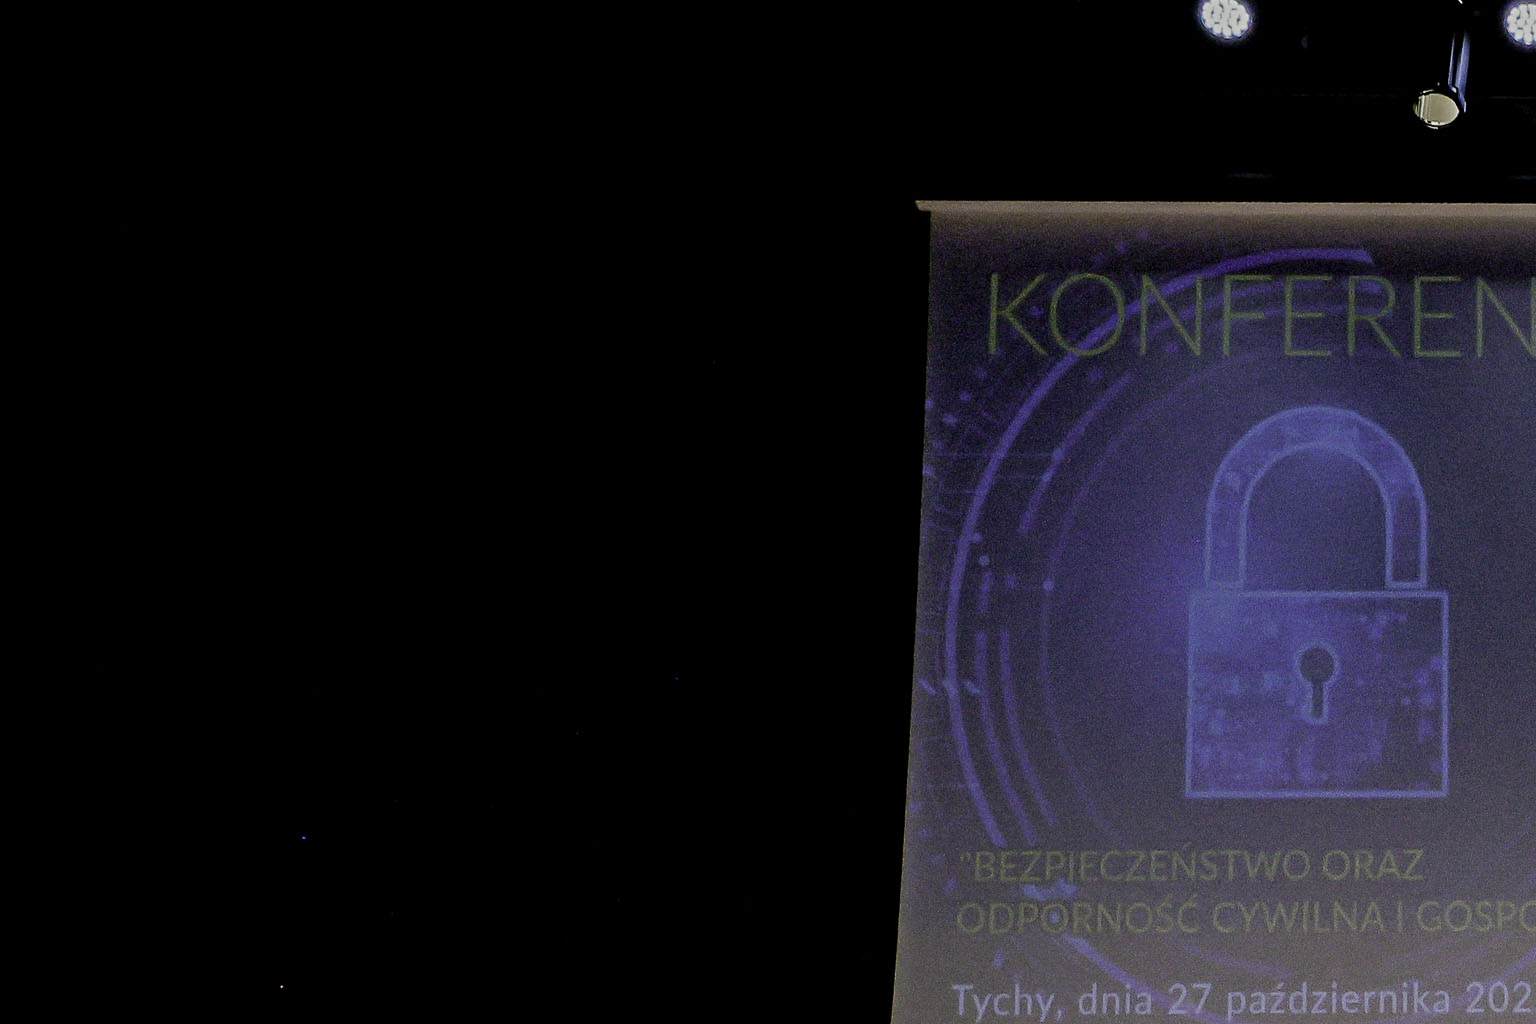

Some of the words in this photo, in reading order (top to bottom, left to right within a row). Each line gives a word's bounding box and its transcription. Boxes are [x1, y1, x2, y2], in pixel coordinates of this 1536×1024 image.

[1321, 849, 1425, 882] ORAZ
[957, 895, 1198, 934] ODPORNOŚĆ
[1212, 902, 1384, 932] CYWILNA
[1398, 903, 1404, 931] I
[952, 984, 1064, 1023] Tychy,
[1078, 983, 1153, 1016] dnia
[1168, 984, 1211, 1016] 27
[1226, 982, 1450, 1022] października
